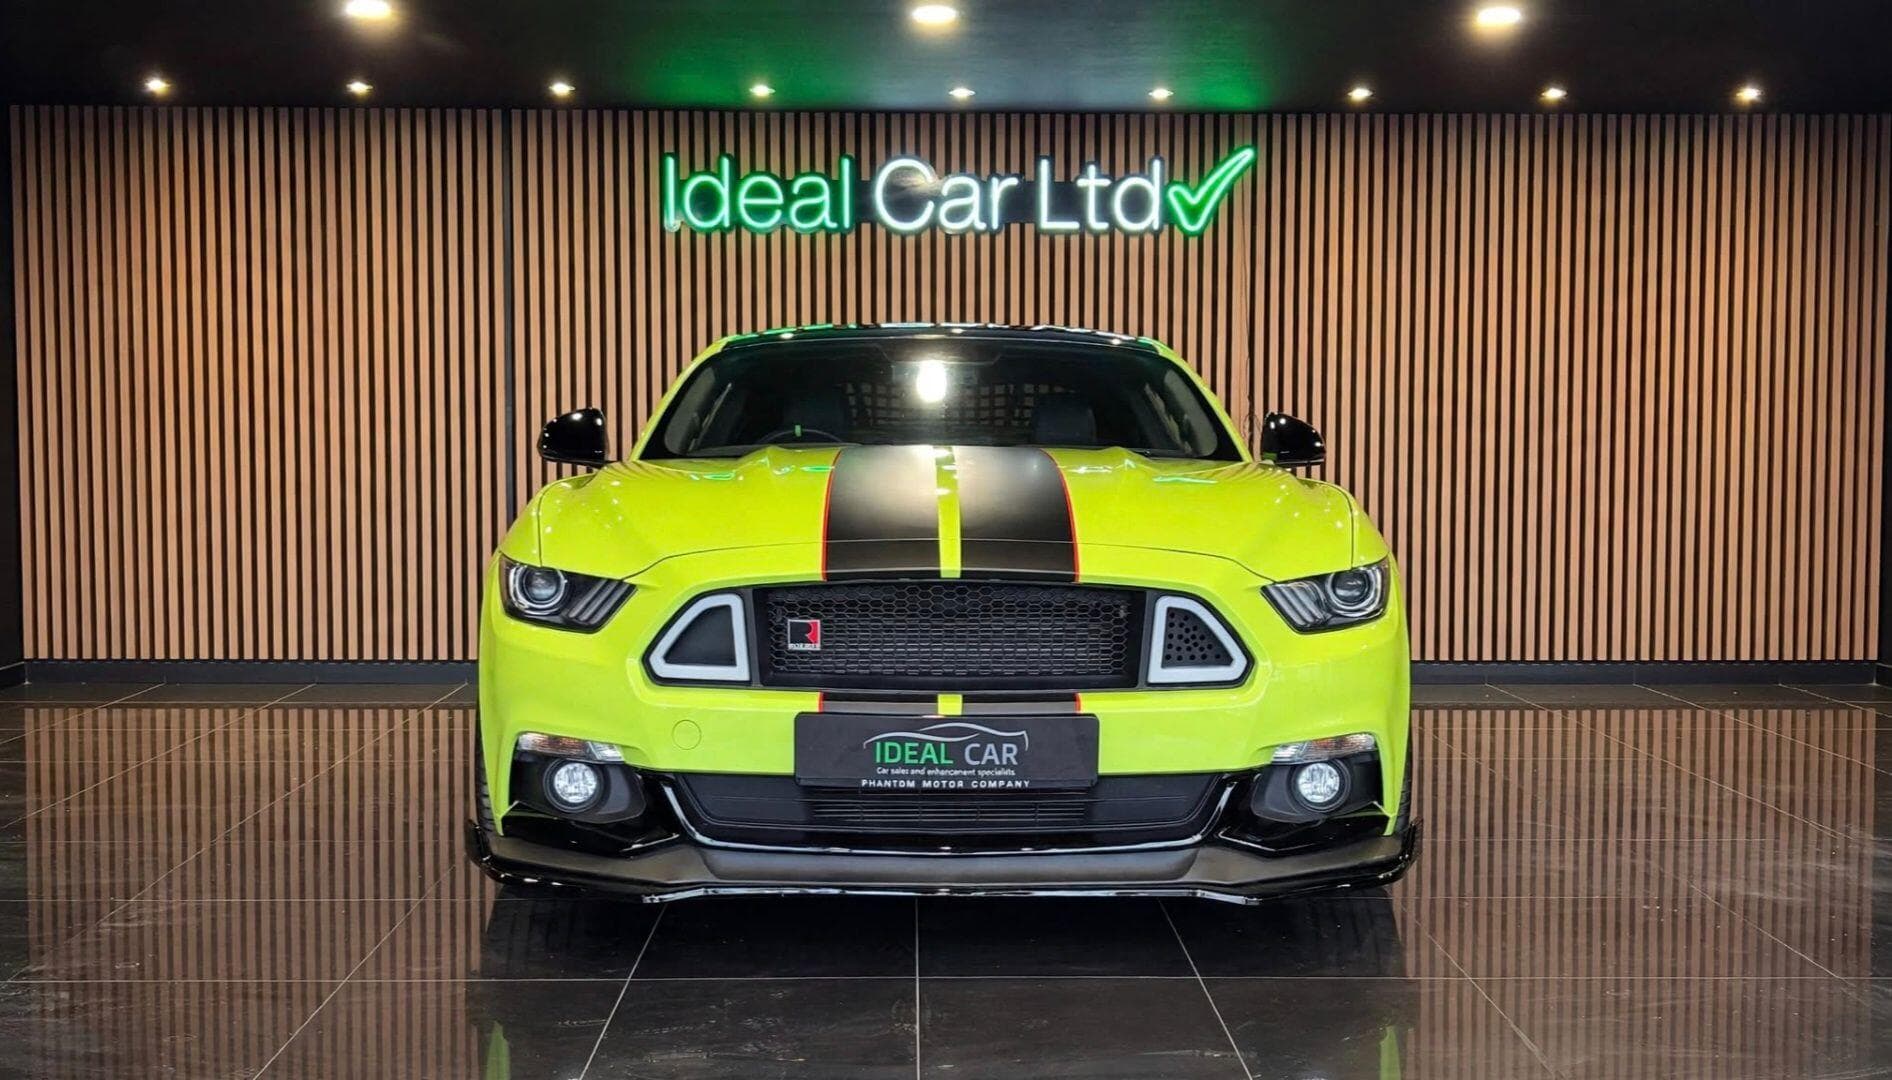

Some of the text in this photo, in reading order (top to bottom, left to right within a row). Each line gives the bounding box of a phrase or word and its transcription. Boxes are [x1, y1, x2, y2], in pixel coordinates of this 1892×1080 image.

[664, 155, 1162, 231] Ideal Car Ltd
[875, 741, 1018, 765] IDEAL CAR
[876, 766, 889, 775] Car
[910, 767, 925, 775] and
[861, 779, 1030, 788] PHANTOM MOTOR COMPANY
